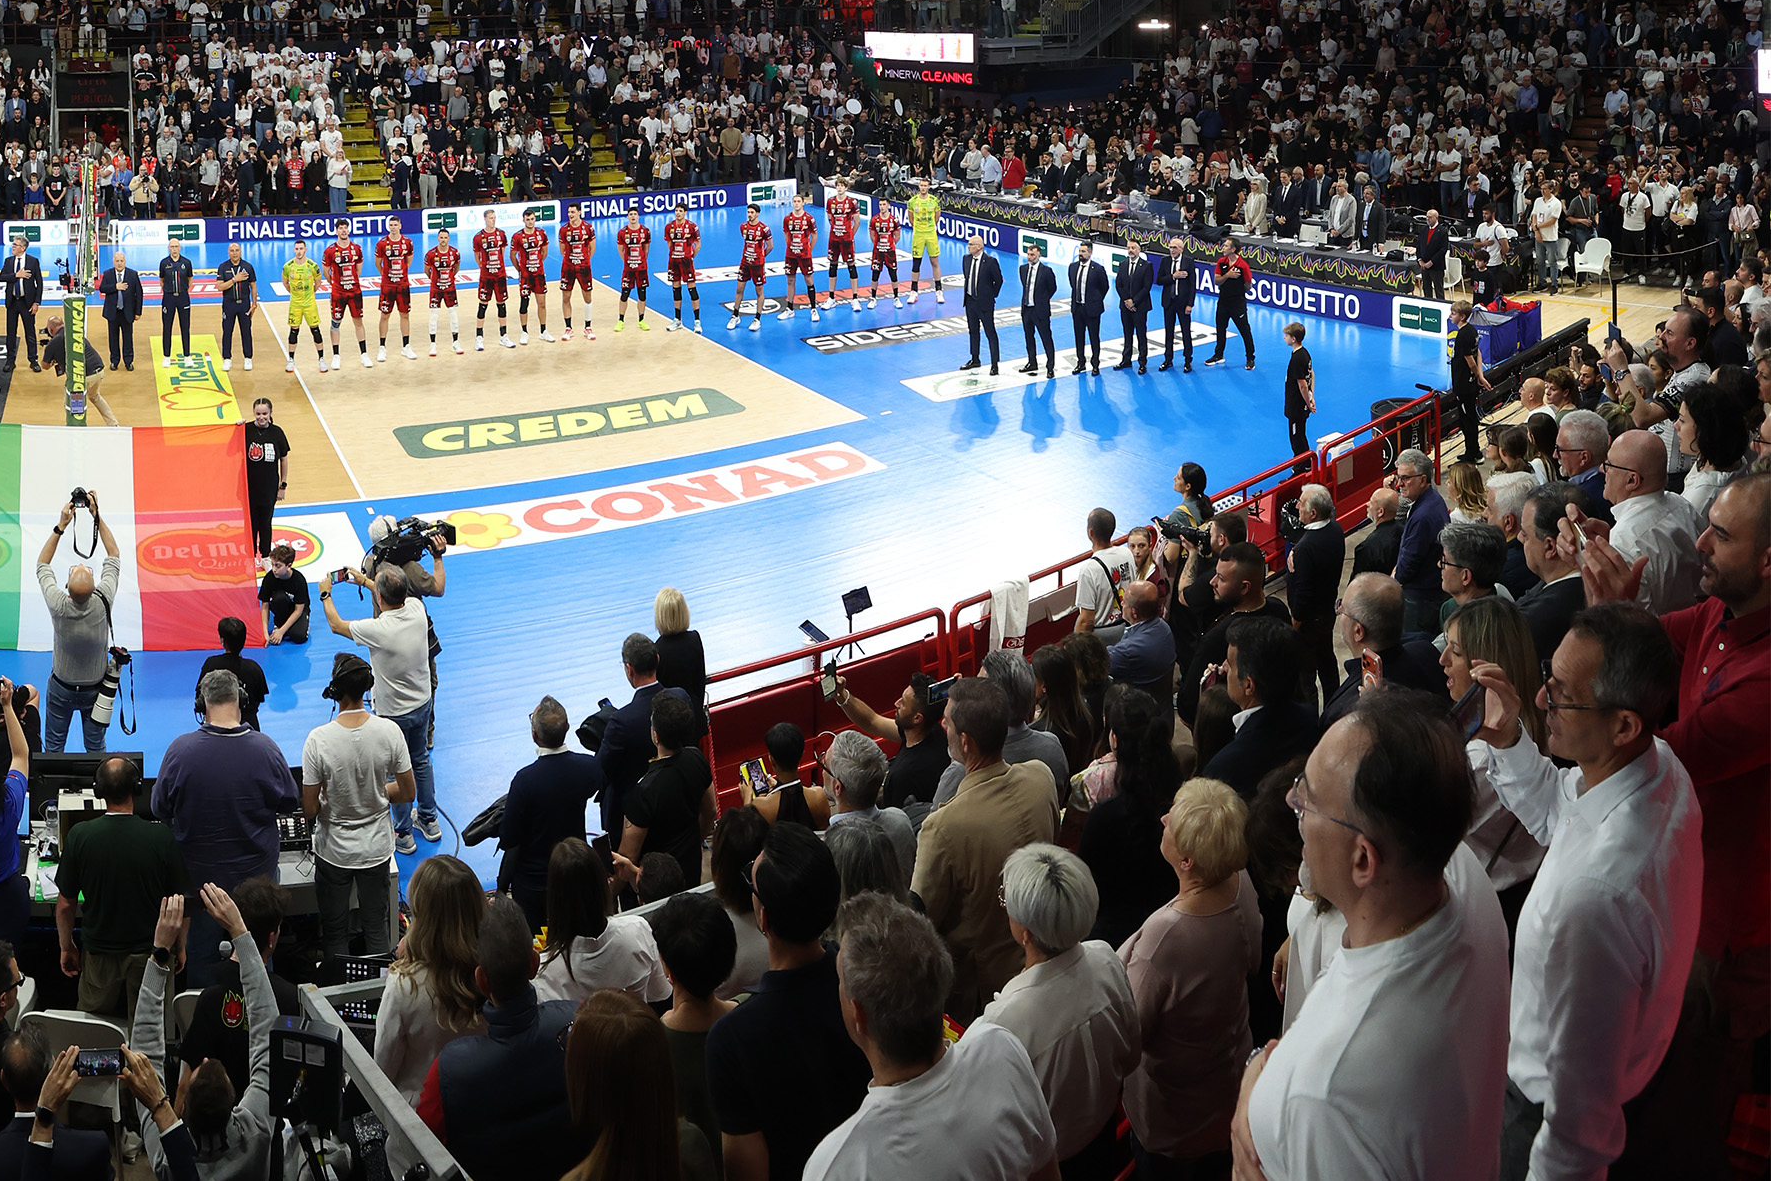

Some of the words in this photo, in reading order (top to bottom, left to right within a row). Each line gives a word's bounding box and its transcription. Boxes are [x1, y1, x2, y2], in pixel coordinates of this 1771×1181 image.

[884, 69, 921, 80] MINERVA
[921, 70, 973, 84] CLEANING
[70, 94, 114, 104] PERUGIA
[580, 197, 639, 219] FINALE
[643, 189, 727, 213] SCUDETTO
[228, 219, 295, 239] FINALE
[1244, 278, 1360, 319] SCUDETTO
[72, 300, 85, 352] BANCA
[420, 392, 710, 452] CREDEM
[523, 449, 867, 533] CONAD
[152, 543, 203, 560] Del
